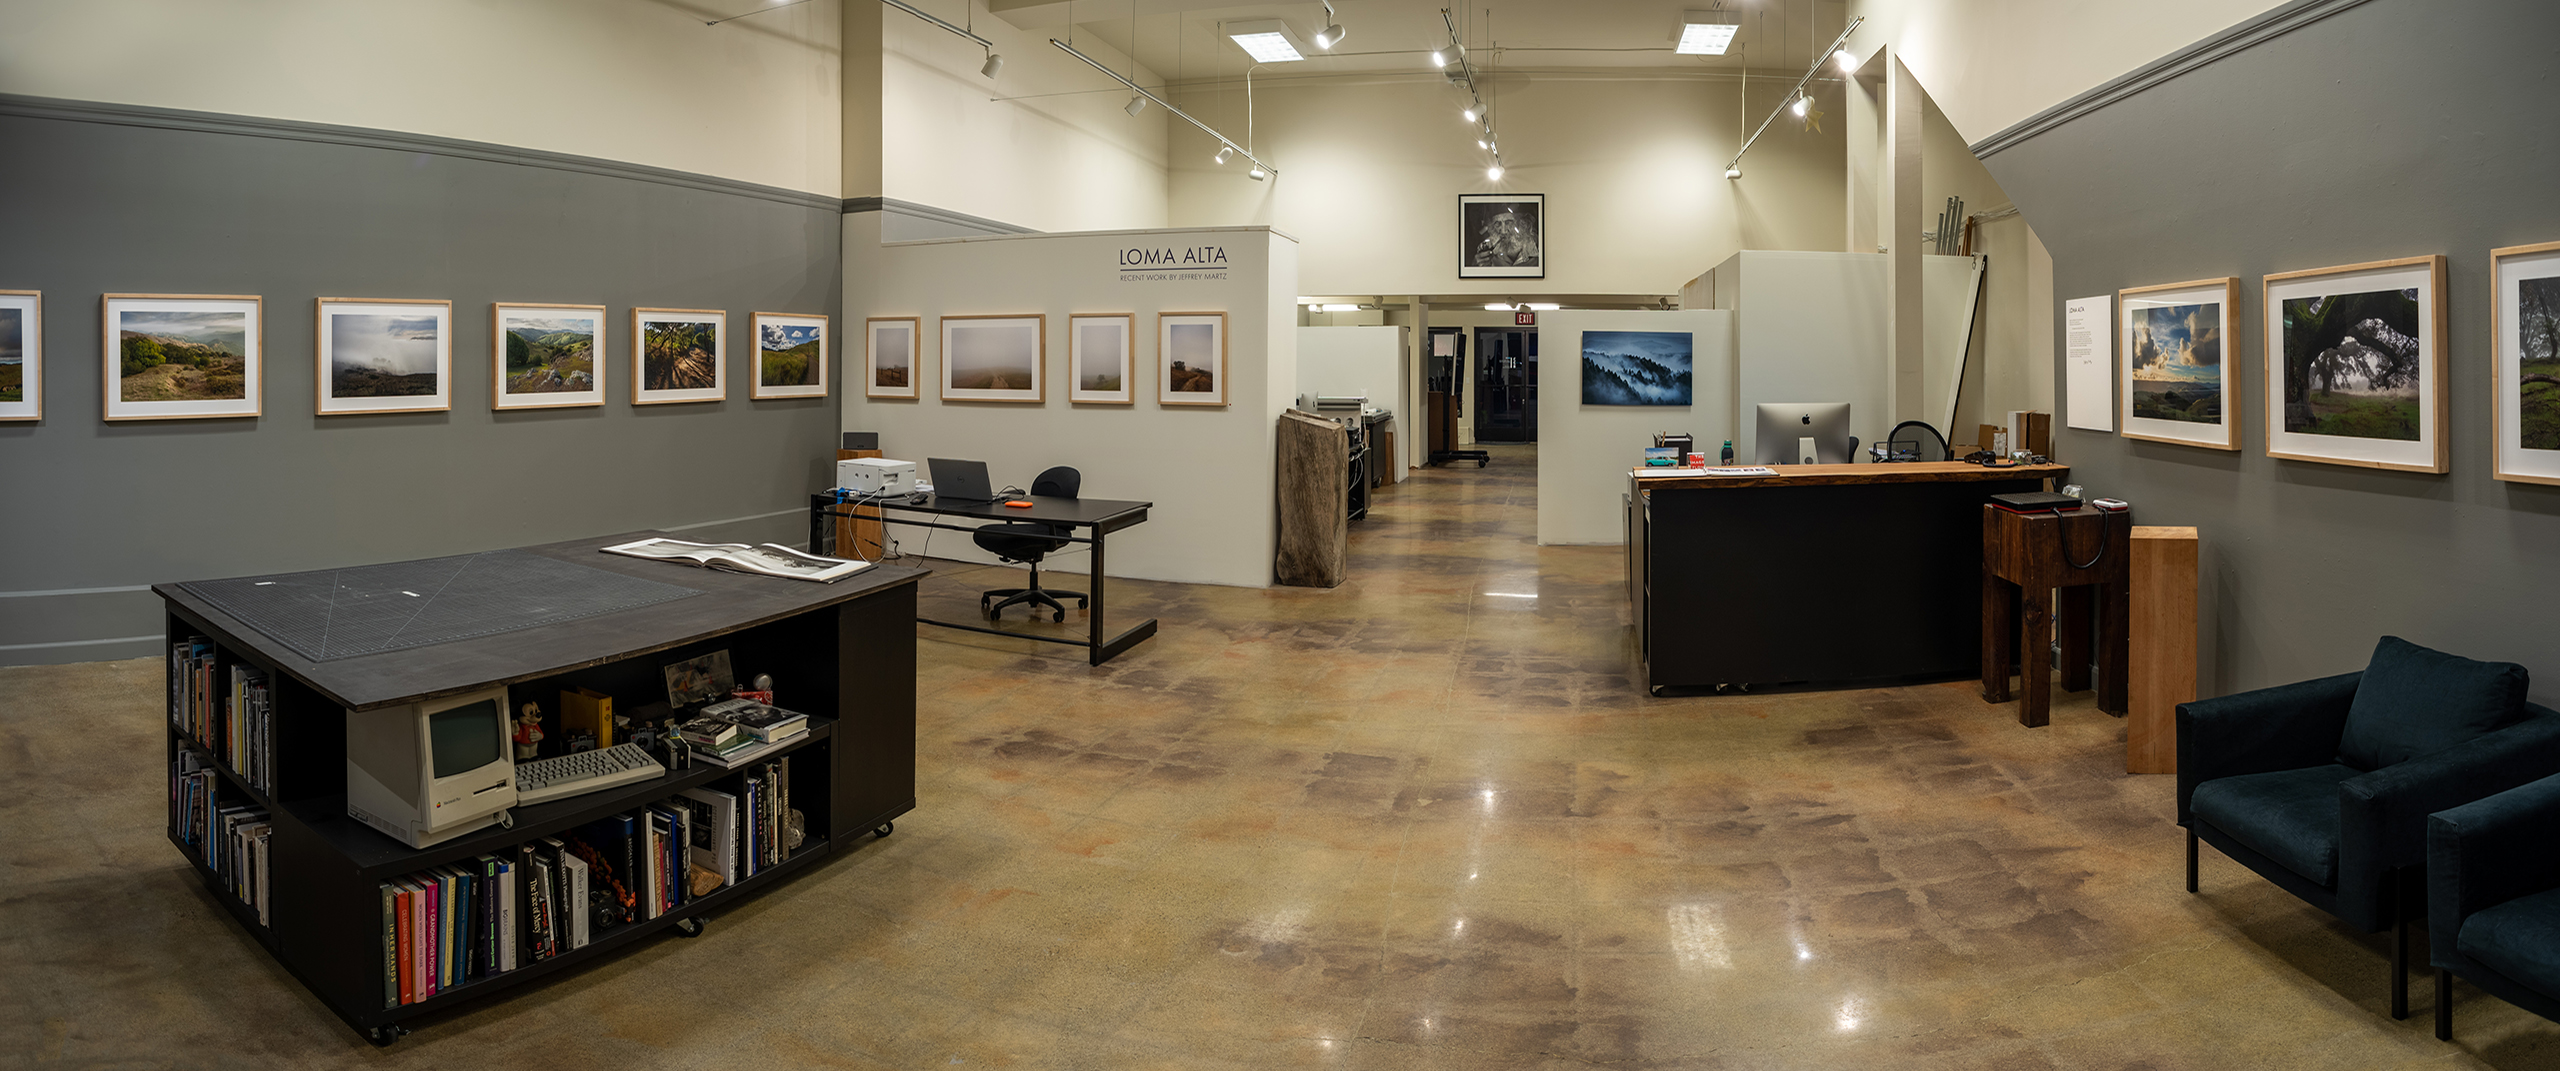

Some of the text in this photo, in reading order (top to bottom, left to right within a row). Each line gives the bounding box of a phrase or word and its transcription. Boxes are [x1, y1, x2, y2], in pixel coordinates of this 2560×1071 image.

[1120, 247, 1227, 265] LOMA ALTA
[1178, 273, 1203, 281] JEFFREY
[1204, 272, 1227, 280] MARTZ
[1519, 314, 1533, 323] EXIT
[531, 891, 539, 907] Face
